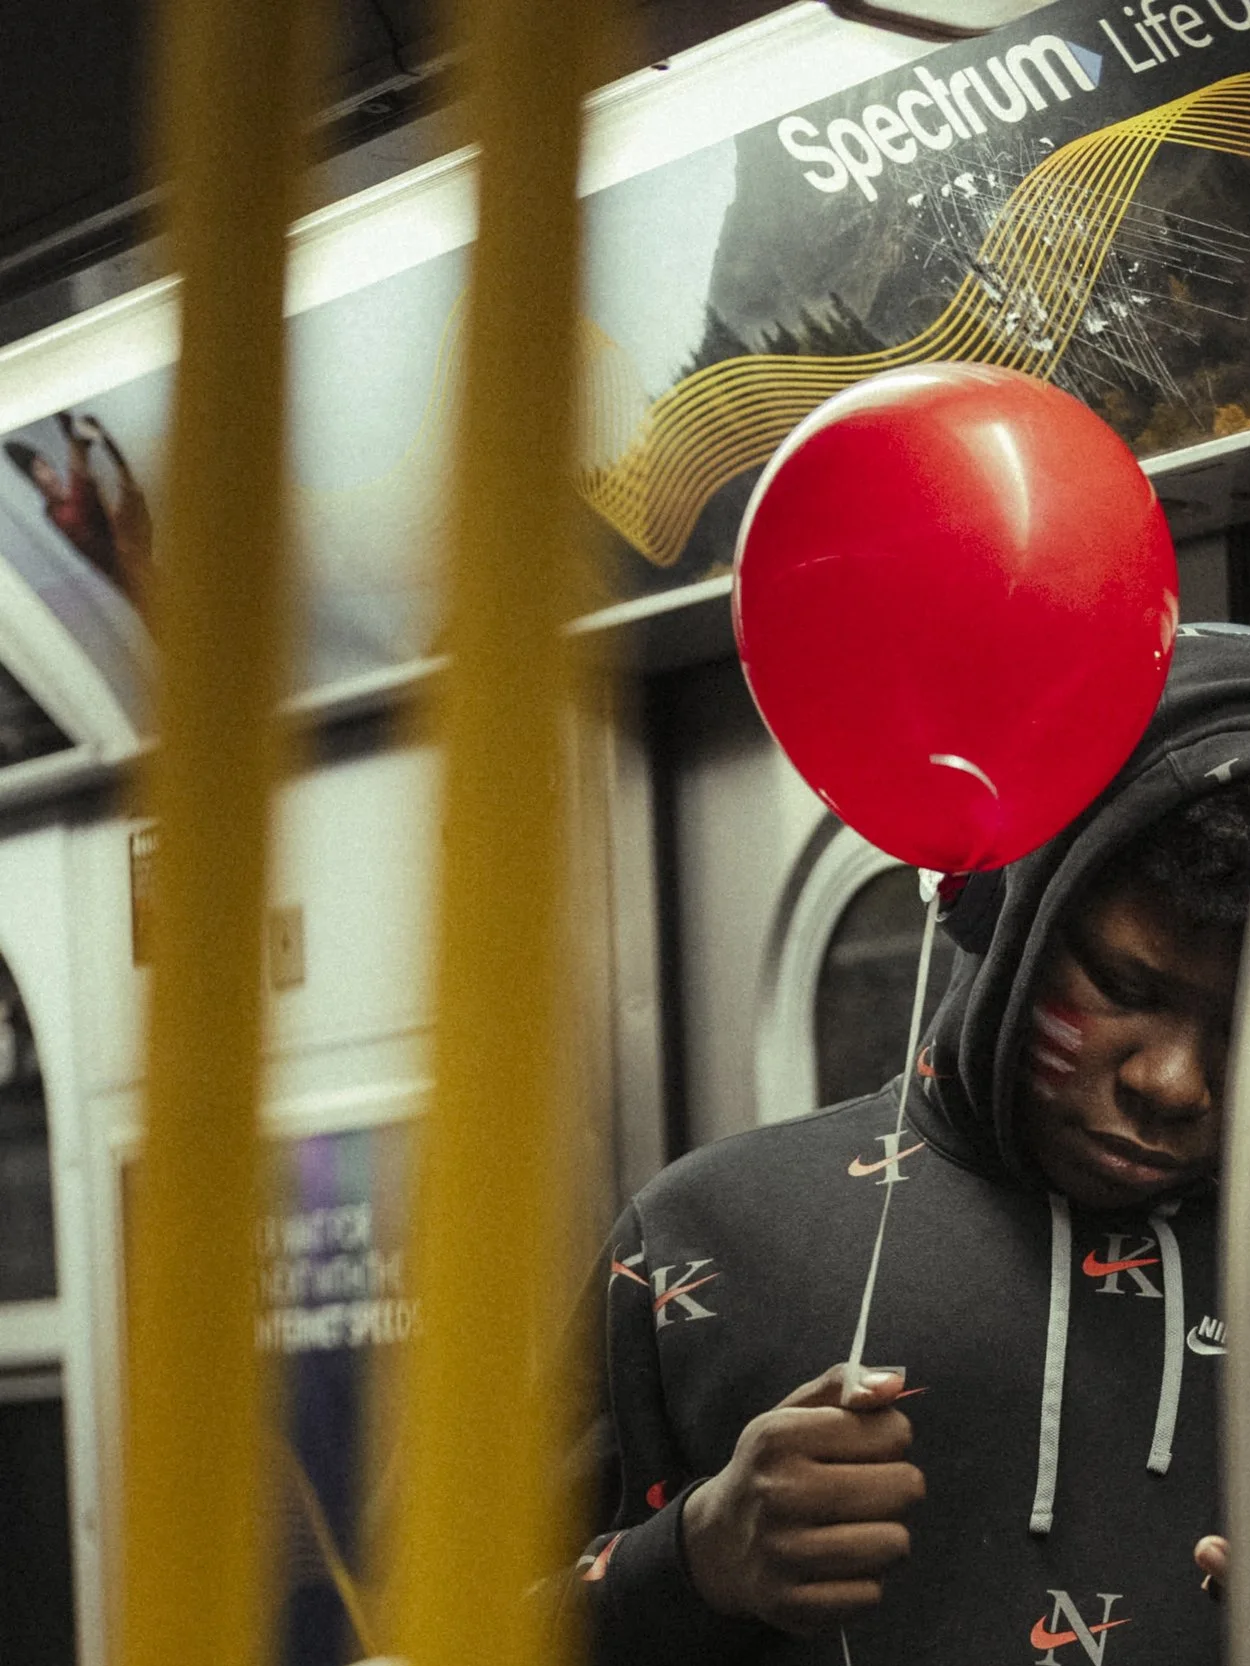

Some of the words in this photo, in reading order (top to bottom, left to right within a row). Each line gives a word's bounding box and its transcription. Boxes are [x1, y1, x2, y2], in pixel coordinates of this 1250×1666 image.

[776, 33, 1096, 203] Spectrum
[1098, 0, 1214, 73] Life
[651, 1257, 718, 1333] K
[1094, 1232, 1164, 1299] K
